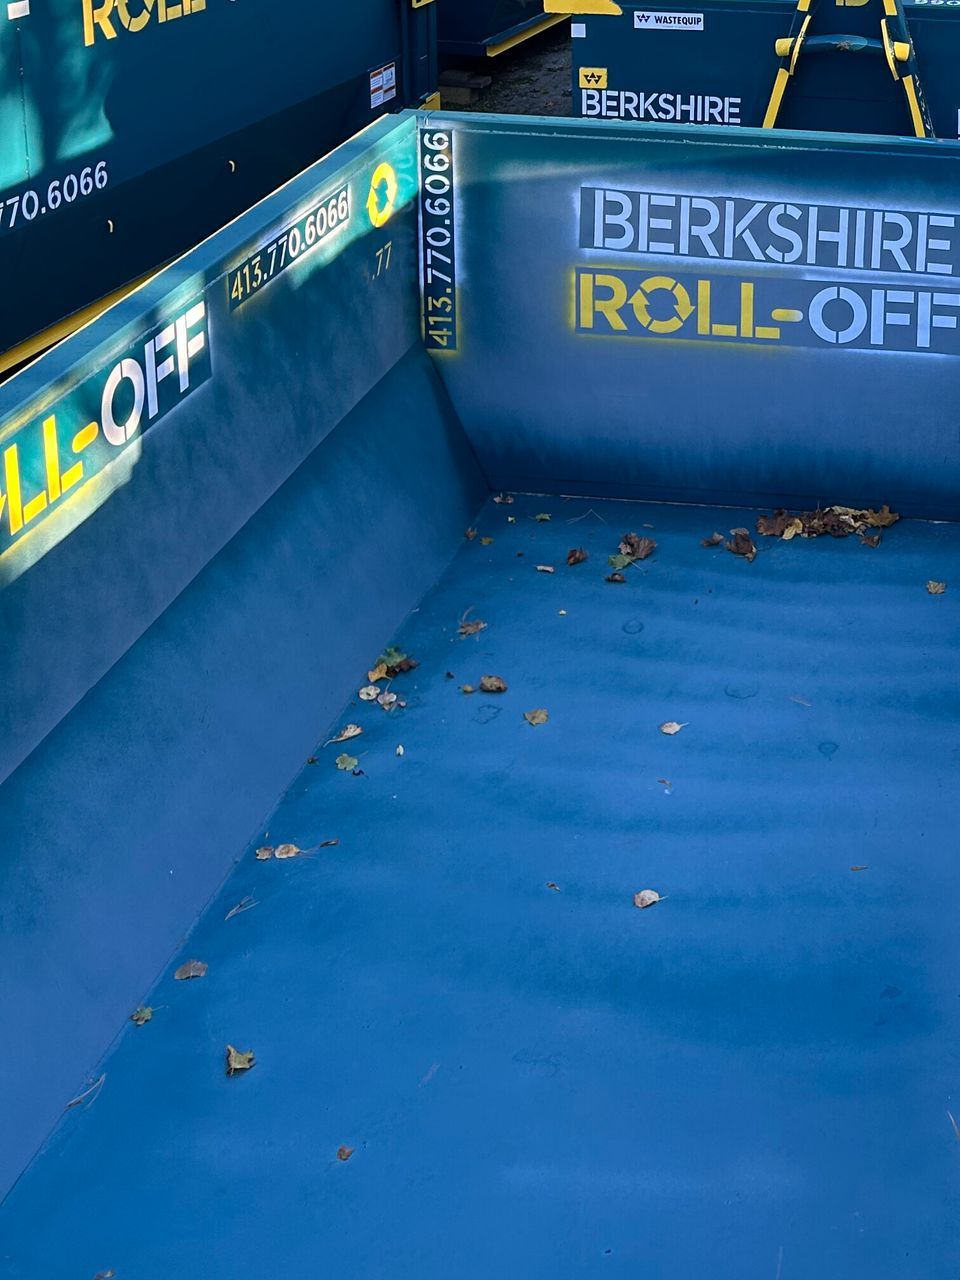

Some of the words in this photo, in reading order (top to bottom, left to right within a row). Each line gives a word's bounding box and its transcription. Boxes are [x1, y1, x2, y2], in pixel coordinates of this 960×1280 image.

[654, 15, 702, 26] WASTEQUIP
[581, 89, 742, 124] BERKSHIRE
[231, 190, 349, 301] 413.770.6066
[423, 131, 453, 347] 413.770.6066
[592, 189, 954, 275] BERKSHIRE
